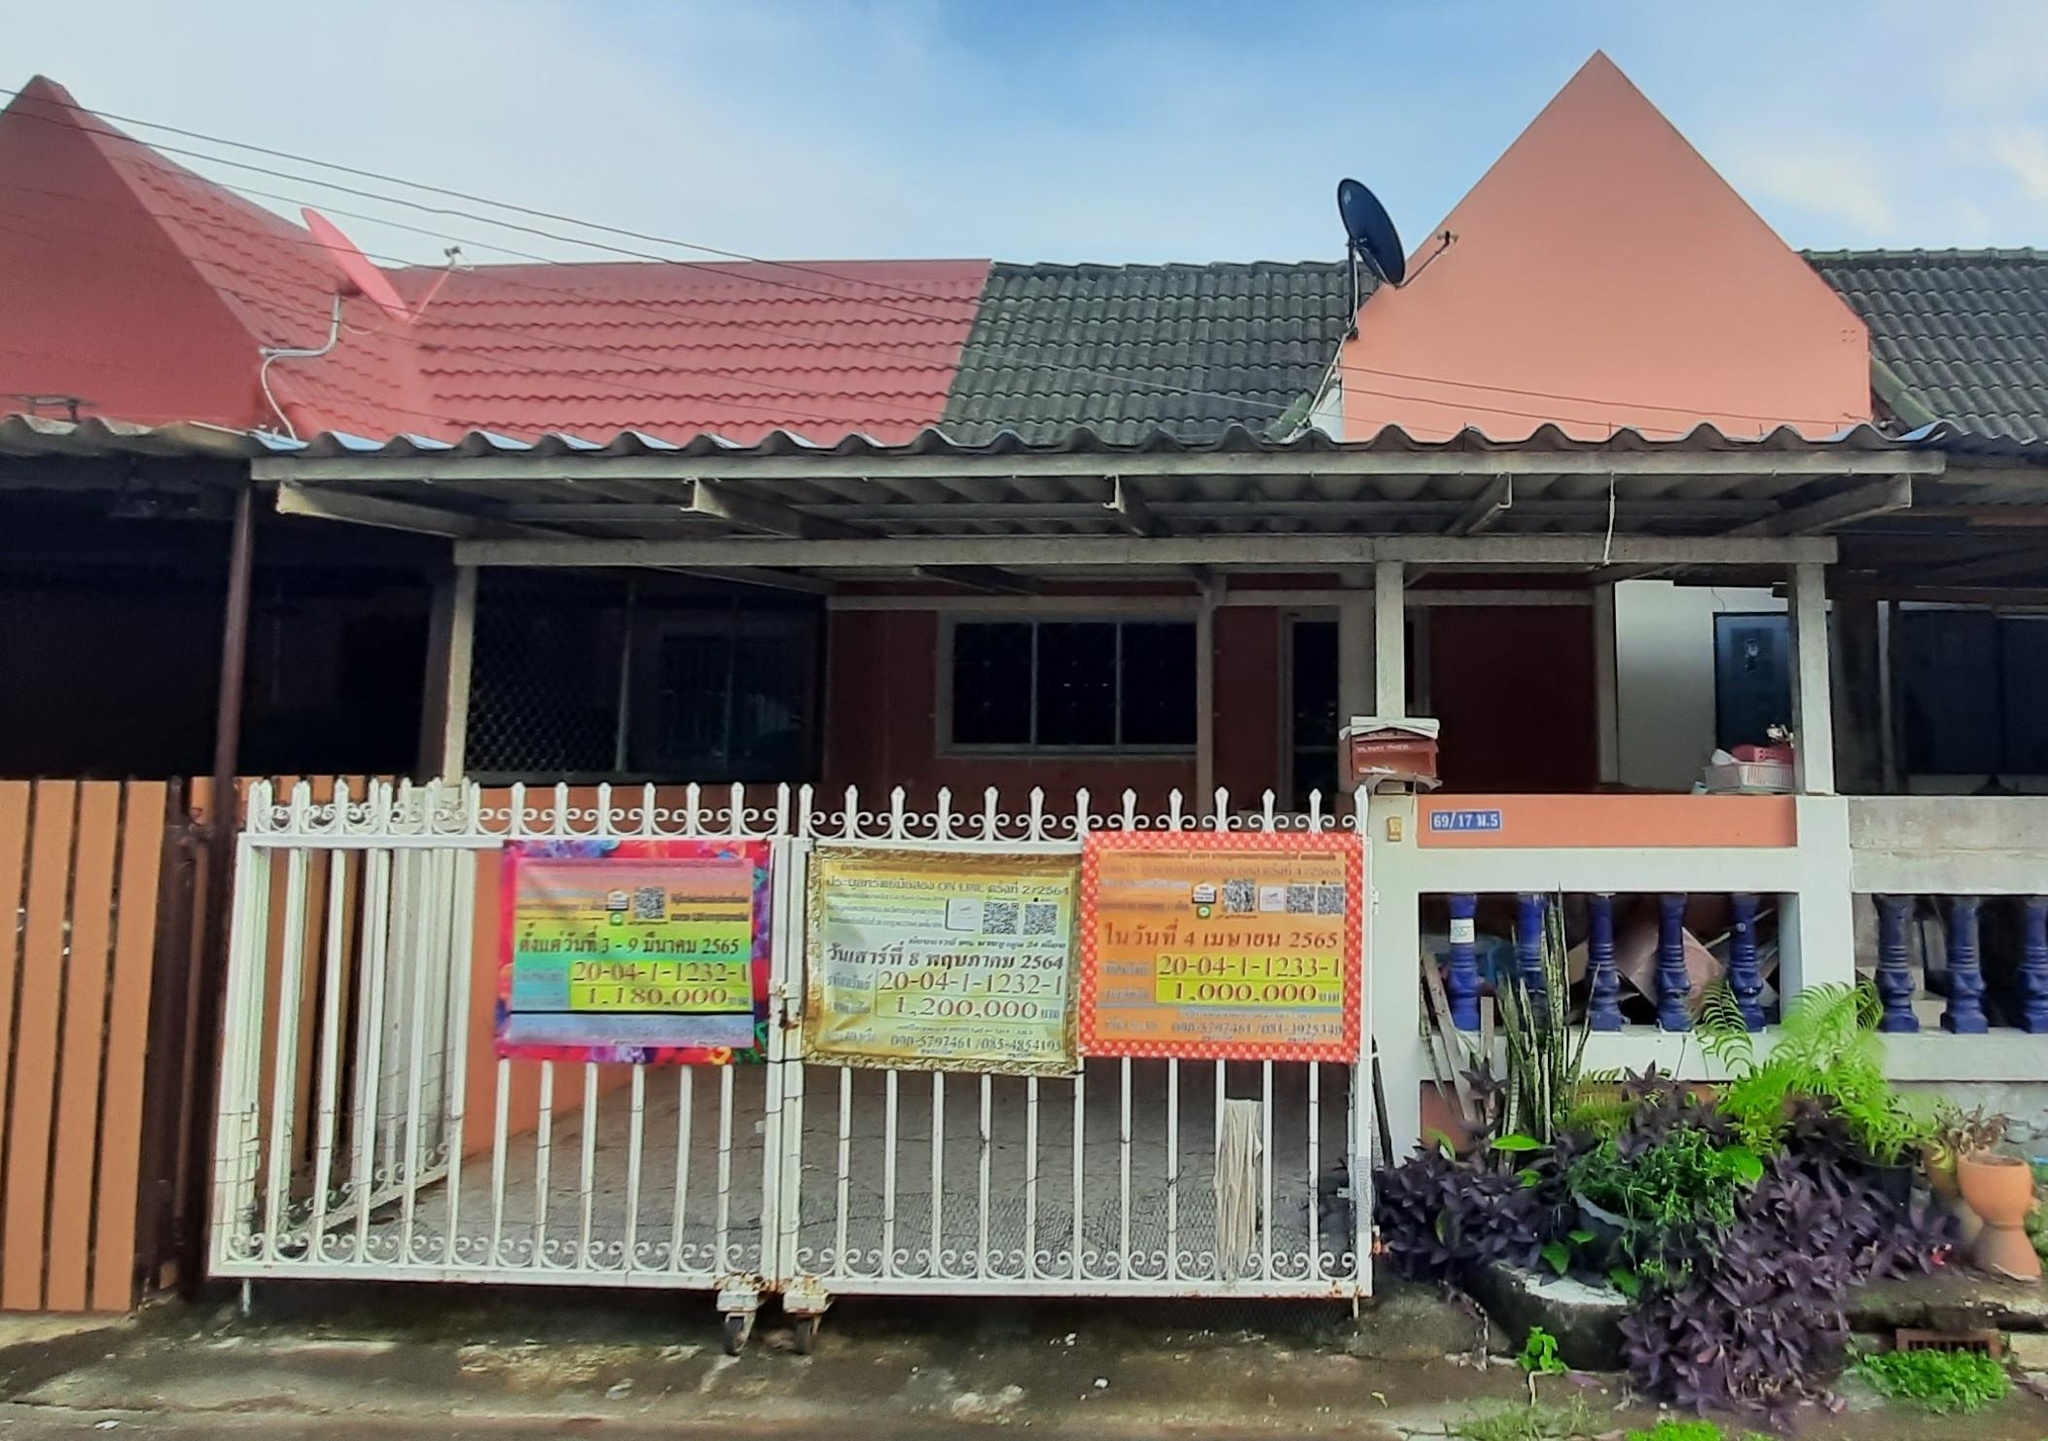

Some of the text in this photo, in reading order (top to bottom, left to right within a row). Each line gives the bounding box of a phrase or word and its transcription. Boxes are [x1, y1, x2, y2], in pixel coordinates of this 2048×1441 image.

[1433, 812, 1473, 829] 69/17
[627, 938, 638, 954] 9
[643, 932, 697, 953] มีนาคม
[702, 938, 740, 954] 2565
[1184, 932, 1195, 947] 4
[1203, 931, 1281, 948] เมษายน
[1289, 931, 1338, 949] 2565
[827, 941, 905, 966] วันเสาร์ที่
[909, 952, 920, 967] 8
[926, 953, 1016, 970] พฤษภาคม
[1020, 954, 1064, 970] 2564
[573, 961, 747, 982] 20-04-1-1232-1
[1159, 956, 1341, 978] 20-04-1-1233-1
[880, 970, 1063, 996] 20-04-1-1232-1
[1175, 982, 1317, 1002] 1,000,000
[897, 996, 1039, 1019] 1,200,000
